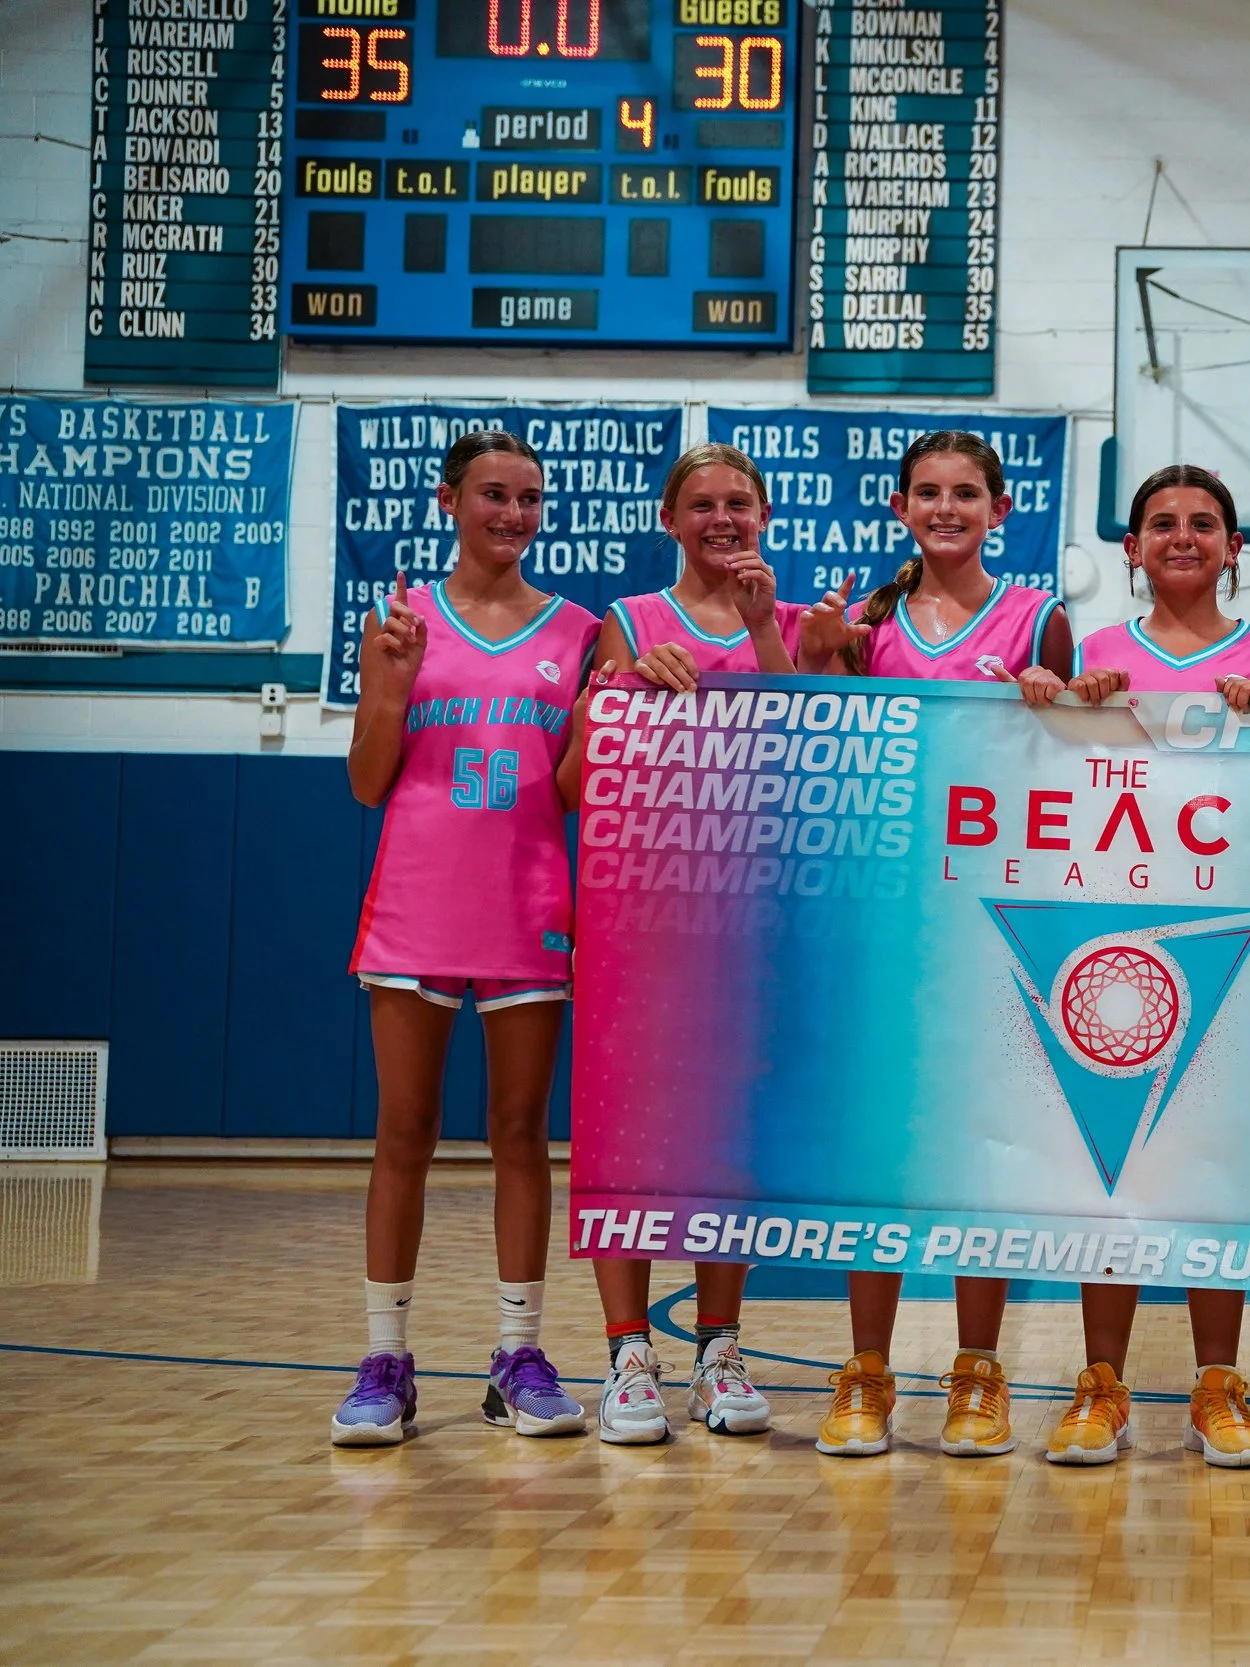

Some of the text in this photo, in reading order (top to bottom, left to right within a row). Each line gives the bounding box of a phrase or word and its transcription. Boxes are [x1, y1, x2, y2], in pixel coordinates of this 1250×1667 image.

[128, 0, 286, 22] ROSENELLO 2
[680, 0, 780, 25] Guests
[851, 11, 999, 37] BOWMAN 2
[129, 20, 286, 50] WAREHAM 3
[488, 0, 600, 57] 0.0
[128, 49, 285, 79] RUSSELL 4
[321, 27, 409, 101] 35
[850, 39, 998, 66] MIKULSKI 4
[694, 36, 782, 109] 30
[849, 67, 998, 94] MCGONIGLE 5
[127, 78, 284, 109] DUNNER 5
[850, 95, 997, 122] KING 11
[126, 107, 283, 138] JACKSON 13
[495, 101, 652, 147] period 4
[849, 124, 997, 151] WALLACE 12
[125, 136, 282, 166] EDWARDI 14
[844, 152, 997, 179] RICHARDS 20
[124, 165, 281, 196] BELISARIO 20
[305, 161, 373, 194] fouls
[397, 166, 456, 195] t.o.l.
[493, 163, 587, 200] player
[621, 170, 680, 199] t.o.l.
[705, 168, 772, 201] fouls
[123, 194, 280, 225] KIKER 21
[845, 180, 996, 208] WAREHAM 23
[847, 208, 995, 237] MURPHY 24
[122, 224, 280, 254] MCGRATH 25
[845, 237, 995, 265] MURPHY 25
[122, 252, 279, 283] RUIZ 30
[845, 265, 994, 293] SARRI 30
[120, 280, 277, 312] RUIZ 33
[307, 291, 363, 317] won
[500, 295, 572, 327] game
[843, 294, 992, 321] DJELLAL 35
[119, 311, 276, 341] CLUNN 34
[707, 301, 762, 323] won
[843, 322, 990, 350] VOGDES 55
[58, 406, 270, 444] BASKETBALL
[527, 418, 664, 455] CATHOLIC
[733, 425, 820, 459] GIRLS
[369, 457, 442, 491] BOYS
[19, 481, 266, 513] NATIONAL DIVISION II
[345, 497, 417, 531] CAPE
[50, 519, 284, 545] 1992 2001 2002 2003
[767, 518, 1005, 557] CHAMPS
[46, 546, 213, 572] 2006 2007 2011
[394, 537, 626, 575] CHAIONS
[34, 572, 261, 609] PAROCHIAL B
[42, 611, 231, 636] 2006 2007 2020
[407, 697, 482, 734] BEACH
[588, 689, 922, 734] CHAMPIONS
[586, 727, 919, 775] CHAMPIONS
[451, 747, 519, 811] 56
[1085, 758, 1149, 789] THE
[584, 768, 917, 817] CHAMPIONS
[582, 810, 915, 858] CHAMPIONS
[580, 851, 911, 899] CHAMPIONS
[577, 1208, 674, 1251] THE
[921, 1225, 1173, 1277] PREMIER
